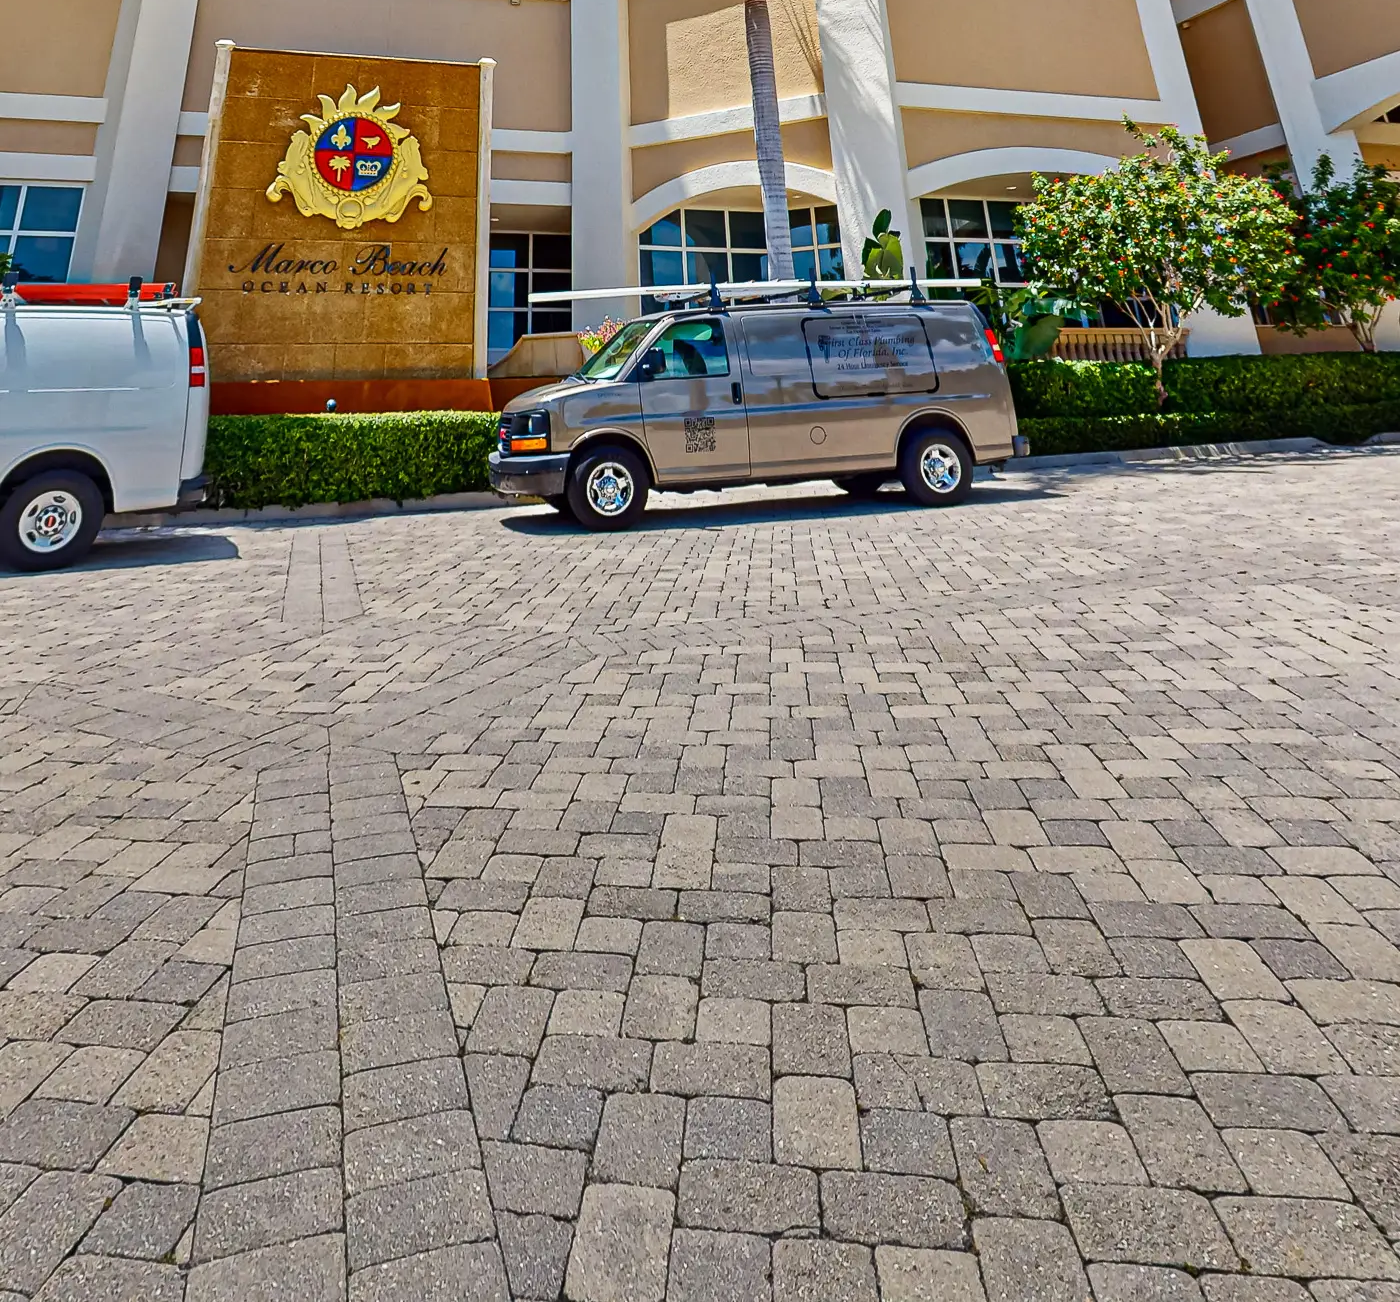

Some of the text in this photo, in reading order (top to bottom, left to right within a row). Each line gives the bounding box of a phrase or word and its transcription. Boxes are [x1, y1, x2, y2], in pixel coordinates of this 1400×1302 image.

[229, 243, 448, 276] Marco Beach
[242, 280, 433, 295] OCEAN RESORT
[848, 336, 871, 347] Class
[875, 334, 915, 347] Plumbing
[838, 348, 850, 361] Of
[837, 362, 845, 371] 24
